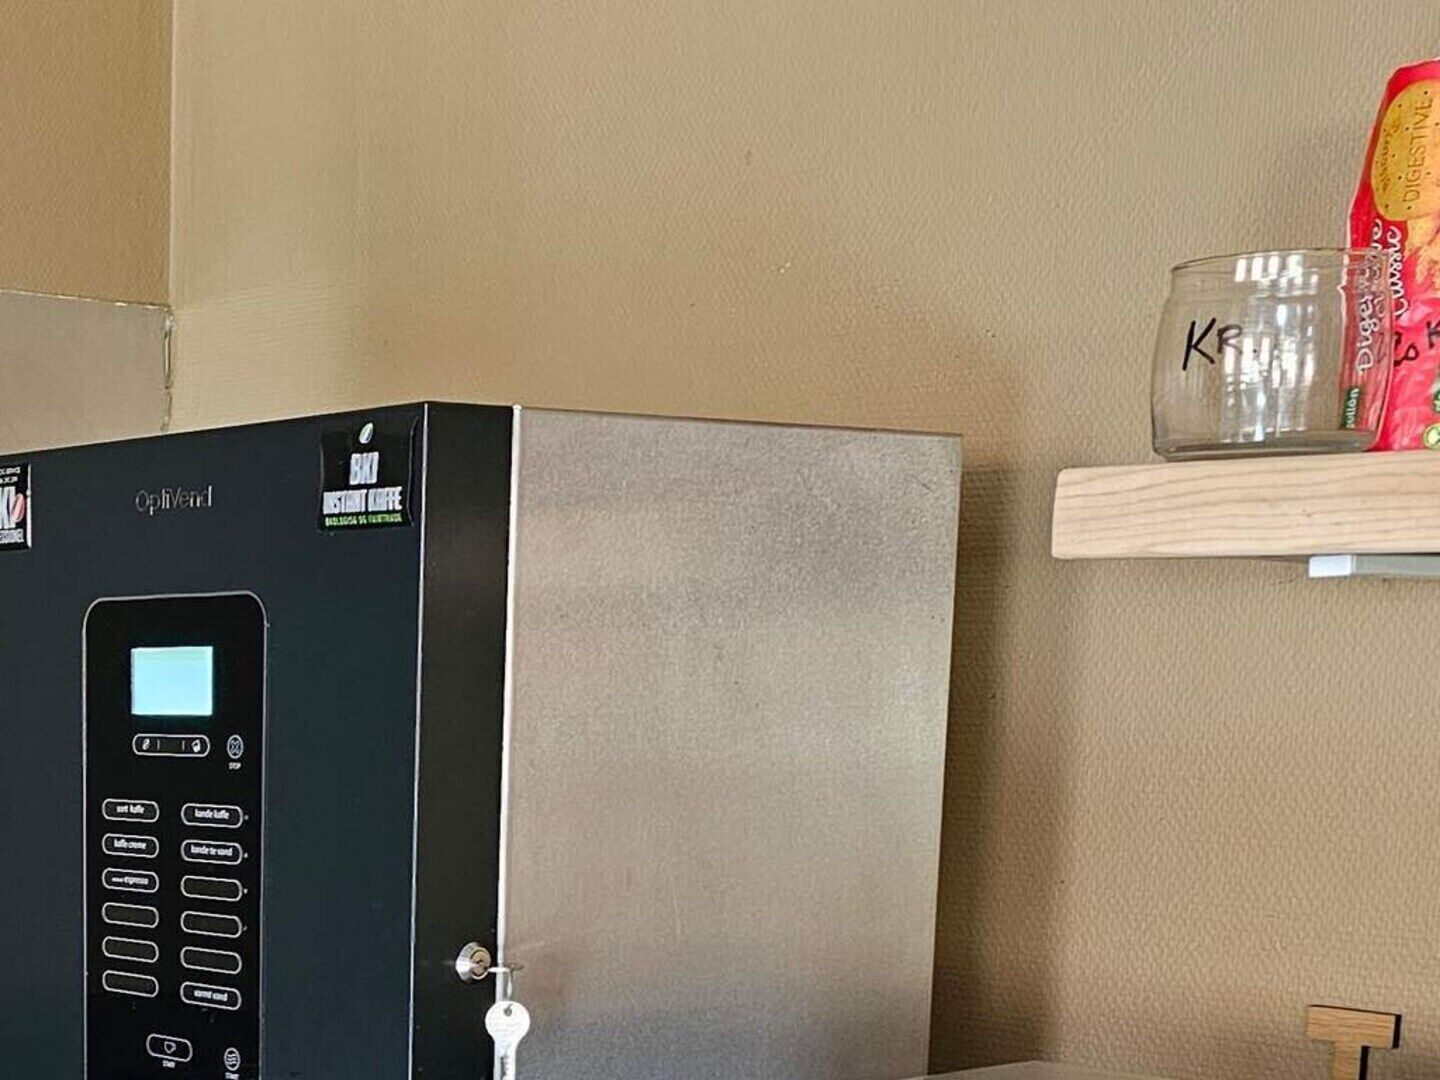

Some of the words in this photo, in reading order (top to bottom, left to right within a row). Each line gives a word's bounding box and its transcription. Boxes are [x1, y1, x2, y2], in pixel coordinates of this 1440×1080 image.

[1402, 98, 1433, 203] DIGESTIVE
[350, 451, 379, 486] BKI
[134, 484, 213, 517] OptiVend
